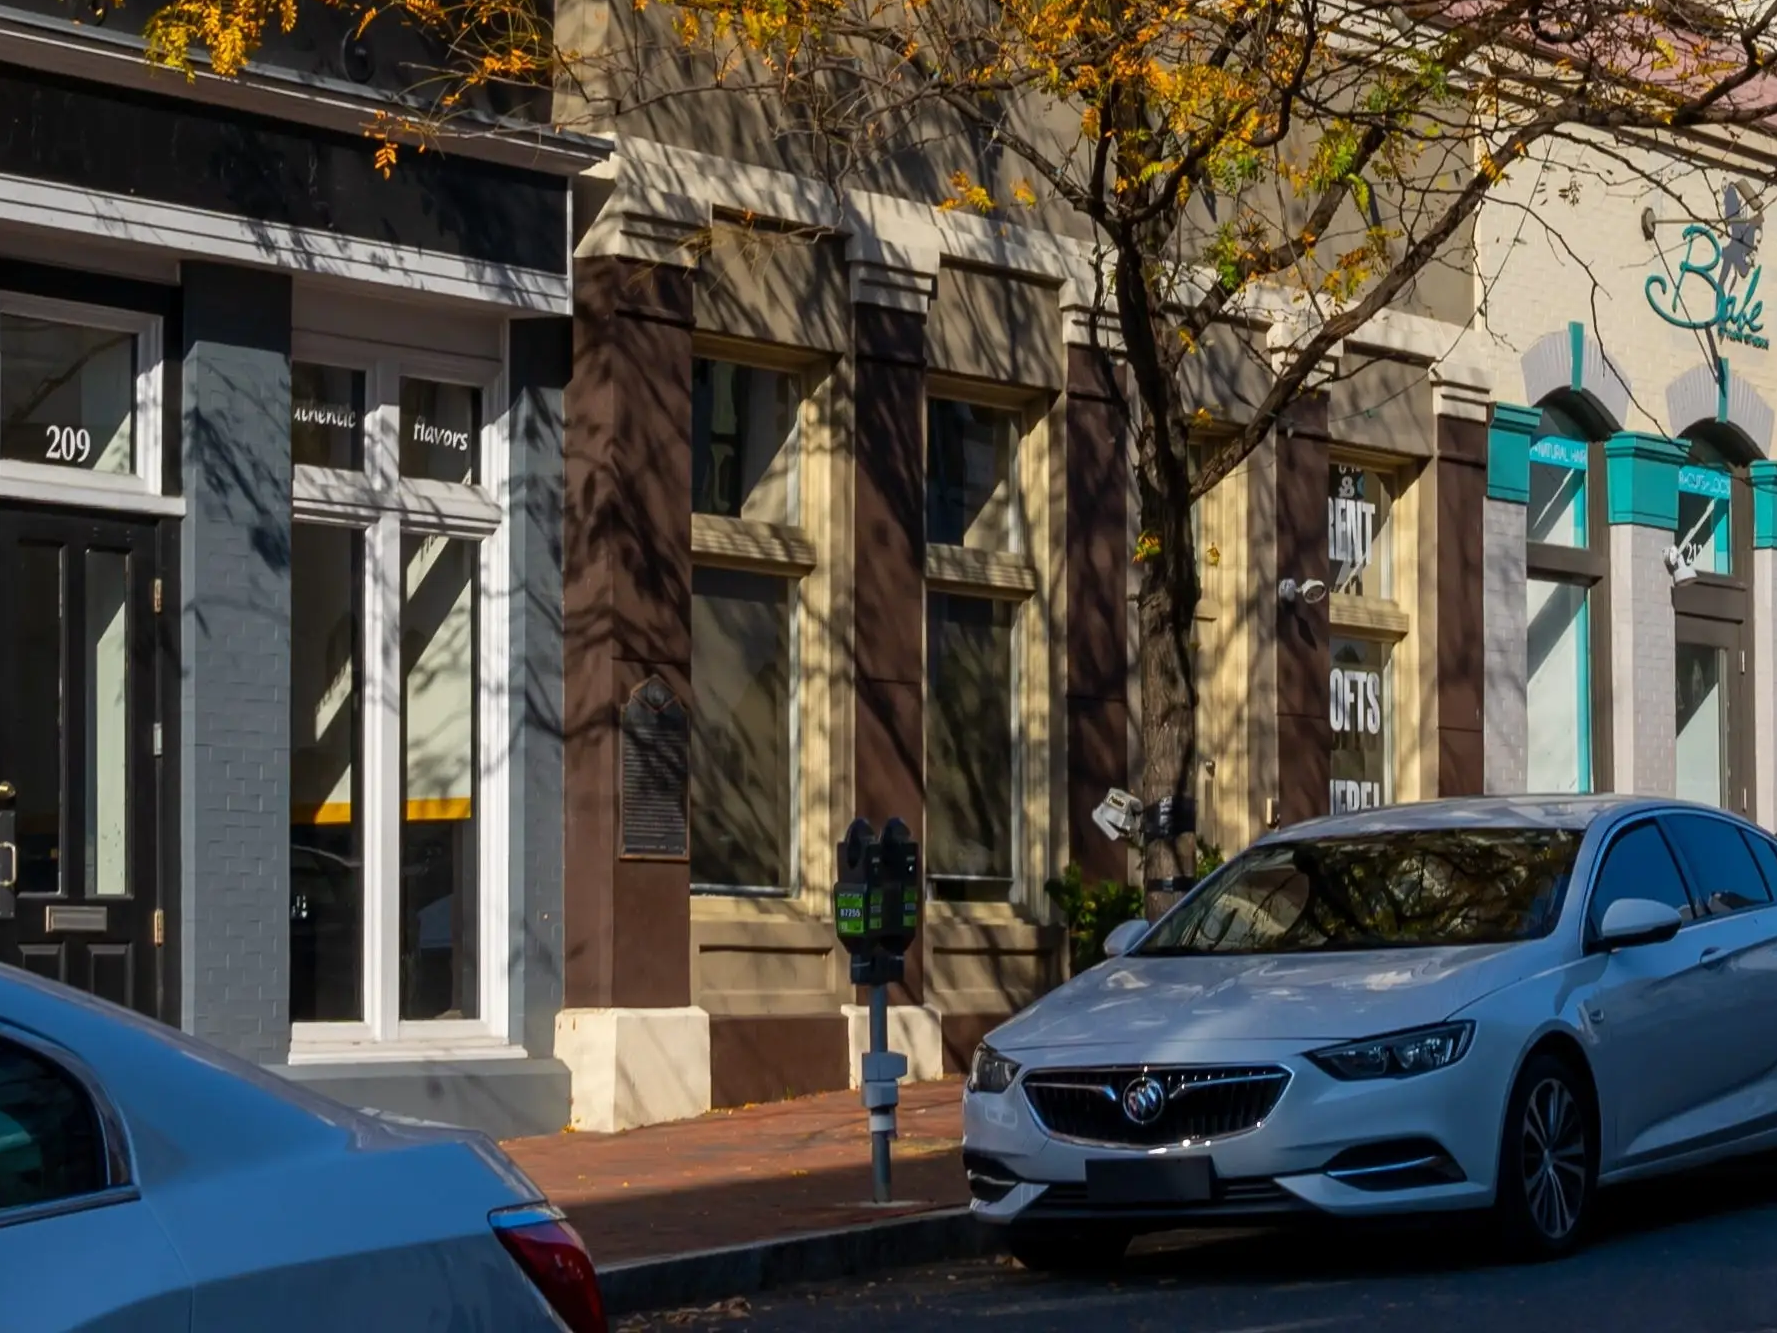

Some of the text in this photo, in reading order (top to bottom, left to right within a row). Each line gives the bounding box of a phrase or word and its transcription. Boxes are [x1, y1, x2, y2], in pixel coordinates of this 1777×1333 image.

[294, 401, 357, 429] uthentic
[413, 415, 469, 451] flavors
[46, 425, 91, 463] 209
[1330, 668, 1381, 734] OFTS
